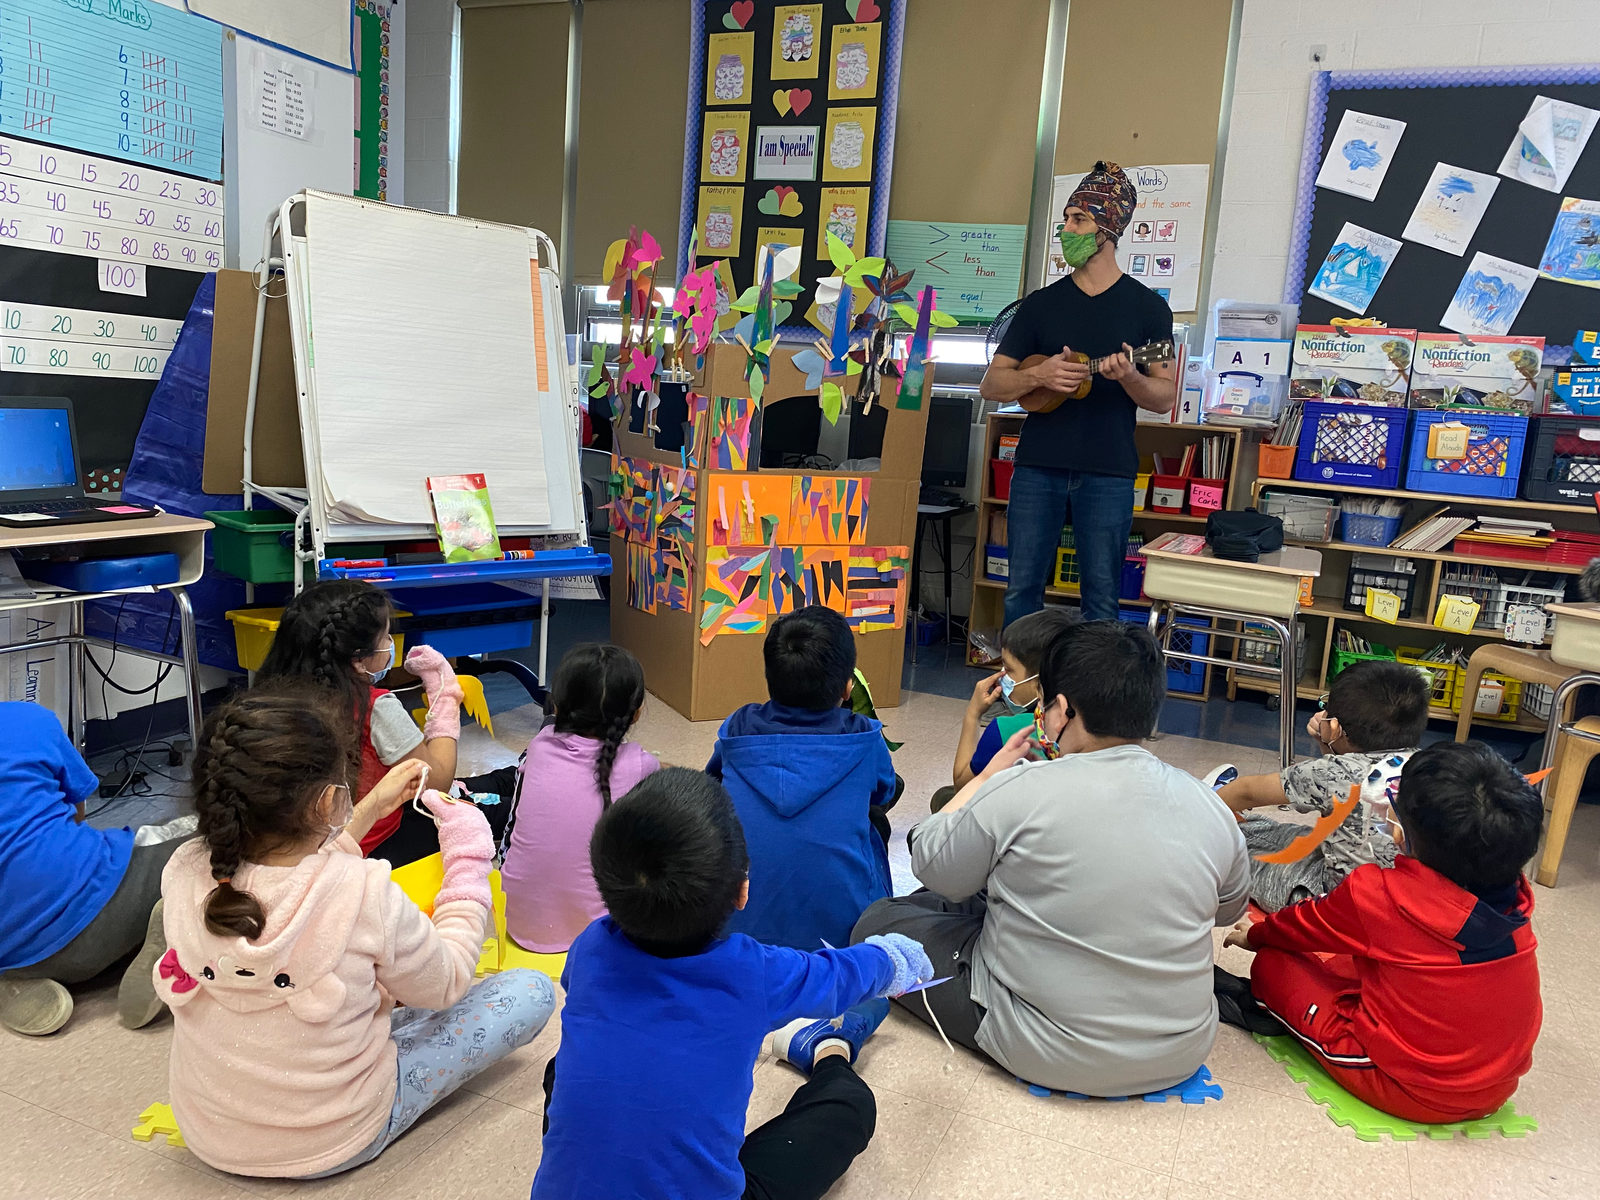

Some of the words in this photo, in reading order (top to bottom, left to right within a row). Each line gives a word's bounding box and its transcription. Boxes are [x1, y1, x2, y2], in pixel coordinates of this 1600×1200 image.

[109, 0, 146, 24] Marks
[759, 135, 764, 157] I
[764, 141, 777, 157] am
[778, 135, 815, 165] Special!!
[40, 155, 56, 174] 10
[81, 164, 97, 182] 15
[119, 172, 139, 191] 20
[159, 181, 182, 199] 25
[195, 188, 216, 206] 30
[1137, 172, 1162, 186] Words
[1152, 198, 1164, 208] the
[1171, 198, 1191, 208] same
[0, 182, 20, 203] 35
[47, 191, 66, 211] 40
[93, 200, 111, 219] 45
[135, 208, 155, 226] 50
[173, 215, 191, 232] 55
[204, 220, 220, 237] 60
[961, 228, 997, 242] greater
[0, 218, 21, 238] 65
[46, 225, 64, 245] 70
[82, 231, 101, 250] 75
[121, 237, 138, 255] 80
[153, 242, 169, 260] 85
[182, 247, 196, 264] 90
[205, 251, 220, 267] 95
[982, 242, 1000, 251] than
[963, 252, 981, 263] less
[975, 266, 996, 276] than
[106, 266, 136, 288] 100
[961, 290, 984, 303] equal
[5, 308, 21, 329] 10
[51, 315, 72, 334] 20
[94, 320, 115, 338] 30
[141, 324, 157, 342] 40
[1301, 340, 1366, 353] Nonfiction
[8, 346, 25, 365] 70
[49, 349, 68, 367] 80
[92, 352, 111, 370] 90
[133, 355, 157, 373] 100
[1232, 351, 1243, 364] A
[1263, 352, 1270, 365] 1
[1307, 349, 1340, 359] Readers
[1422, 348, 1491, 362] Nonfiction
[1428, 358, 1463, 368] Readers
[1184, 401, 1190, 413] 4
[1440, 433, 1458, 441] Read
[1441, 443, 1462, 452] Alouds
[1193, 486, 1212, 497] Eric
[1198, 497, 1218, 507] Carle
[1377, 597, 1395, 608] Level
[1382, 606, 1388, 614] A
[1451, 606, 1473, 617] Level
[1453, 617, 1461, 625] A
[1520, 617, 1540, 628] Level
[26, 617, 55, 640] An
[1525, 627, 1531, 635] B
[26, 657, 55, 703] Learnin
[1478, 692, 1498, 700] Level
[1480, 700, 1486, 708] E
